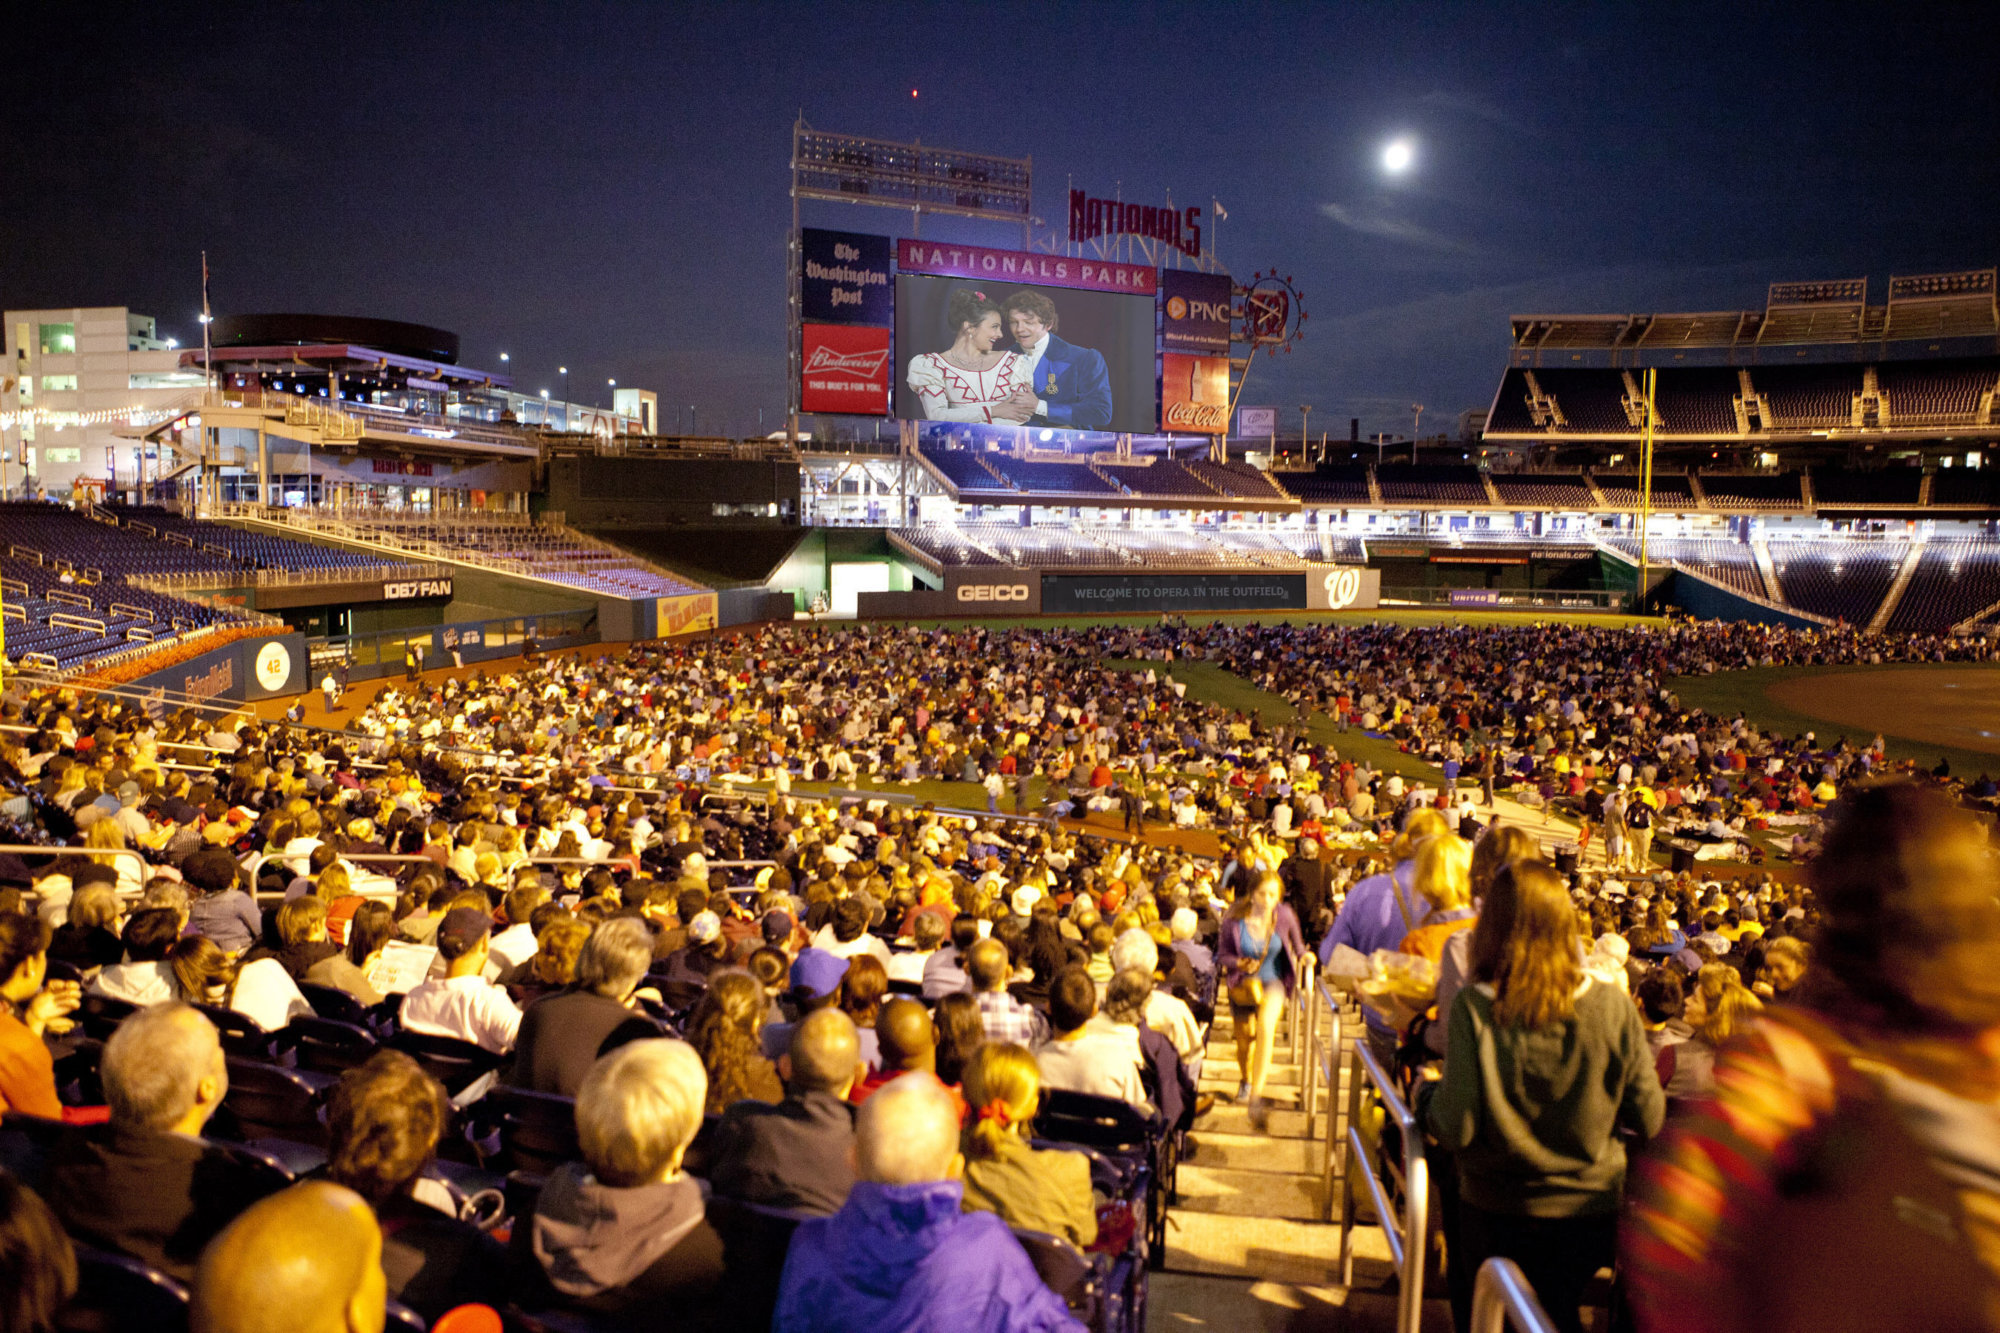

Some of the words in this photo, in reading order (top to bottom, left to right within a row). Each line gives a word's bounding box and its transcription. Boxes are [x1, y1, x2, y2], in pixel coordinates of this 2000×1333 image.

[1070, 189, 1200, 258] NATIONALS
[834, 243, 860, 262] The
[806, 259, 887, 287] Washington
[909, 247, 1068, 279] NATIONALS
[1082, 265, 1146, 288] PARK
[831, 287, 863, 307] Post
[1189, 300, 1230, 323] PNC
[811, 352, 881, 368] Budweiser
[809, 381, 826, 390] THIS
[850, 382, 865, 391] FOR
[420, 580, 452, 597] FAN
[957, 584, 1029, 601] GEICO
[1074, 588, 1132, 599] WELCOME
[1135, 587, 1150, 598] TO
[1153, 587, 1191, 598] OPERA
[1193, 587, 1206, 597] IN
[1209, 586, 1230, 597] THE
[1232, 586, 1285, 597] OUTFIELD
[266, 659, 281, 674] 42
